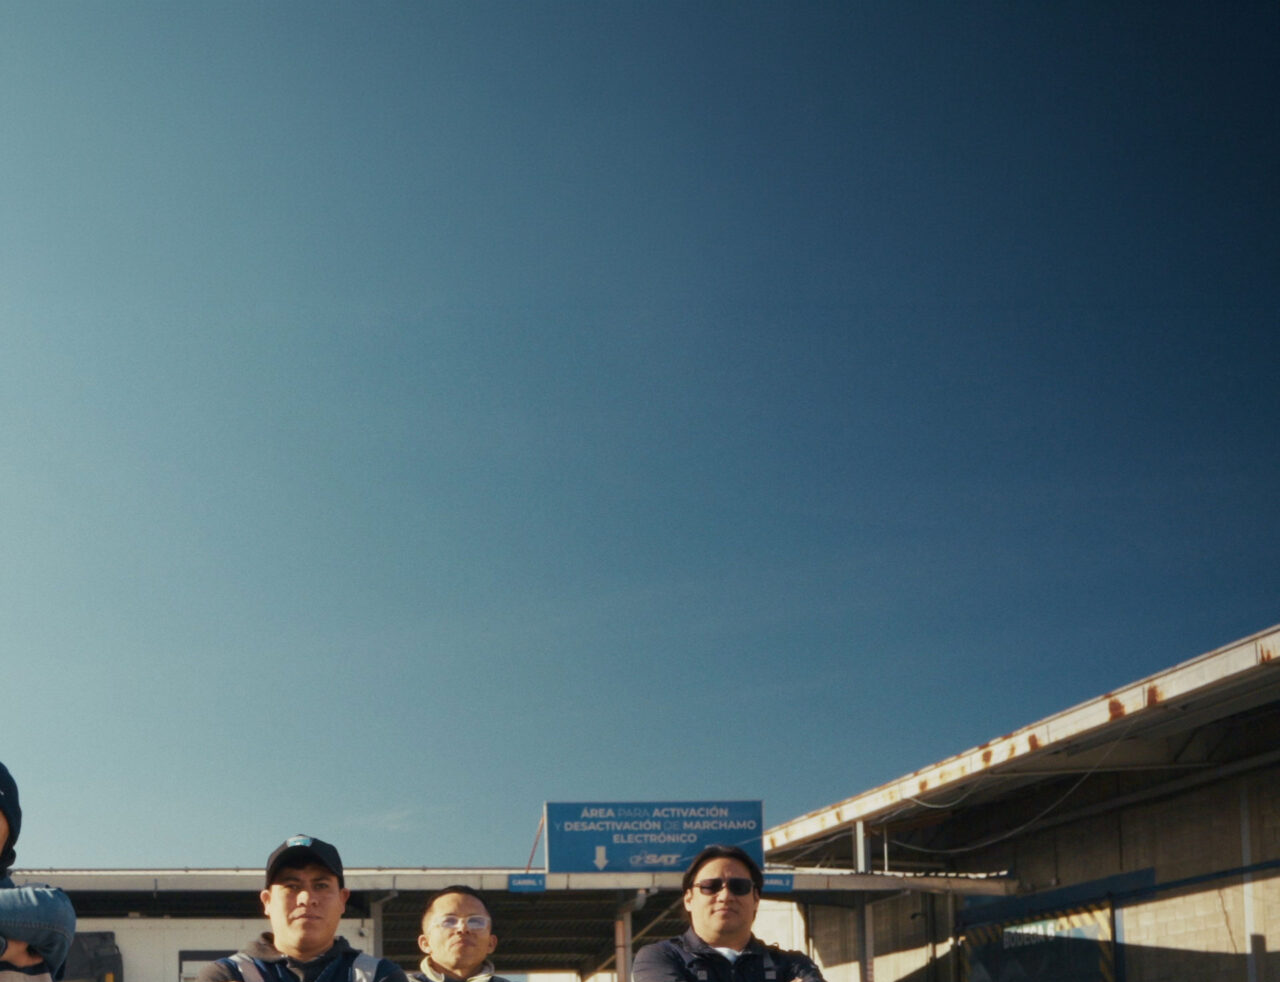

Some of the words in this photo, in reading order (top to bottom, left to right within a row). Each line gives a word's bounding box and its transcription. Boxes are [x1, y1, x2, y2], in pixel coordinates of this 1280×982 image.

[581, 807, 615, 818] ÁREA
[618, 808, 650, 818] PARA
[652, 806, 729, 818] ACTIVACIÓN
[564, 820, 661, 832] DESACTIVACIÓN
[663, 822, 680, 831] DE
[683, 820, 757, 831] MARCHAMO
[612, 832, 698, 844] ELECTRÓNICO
